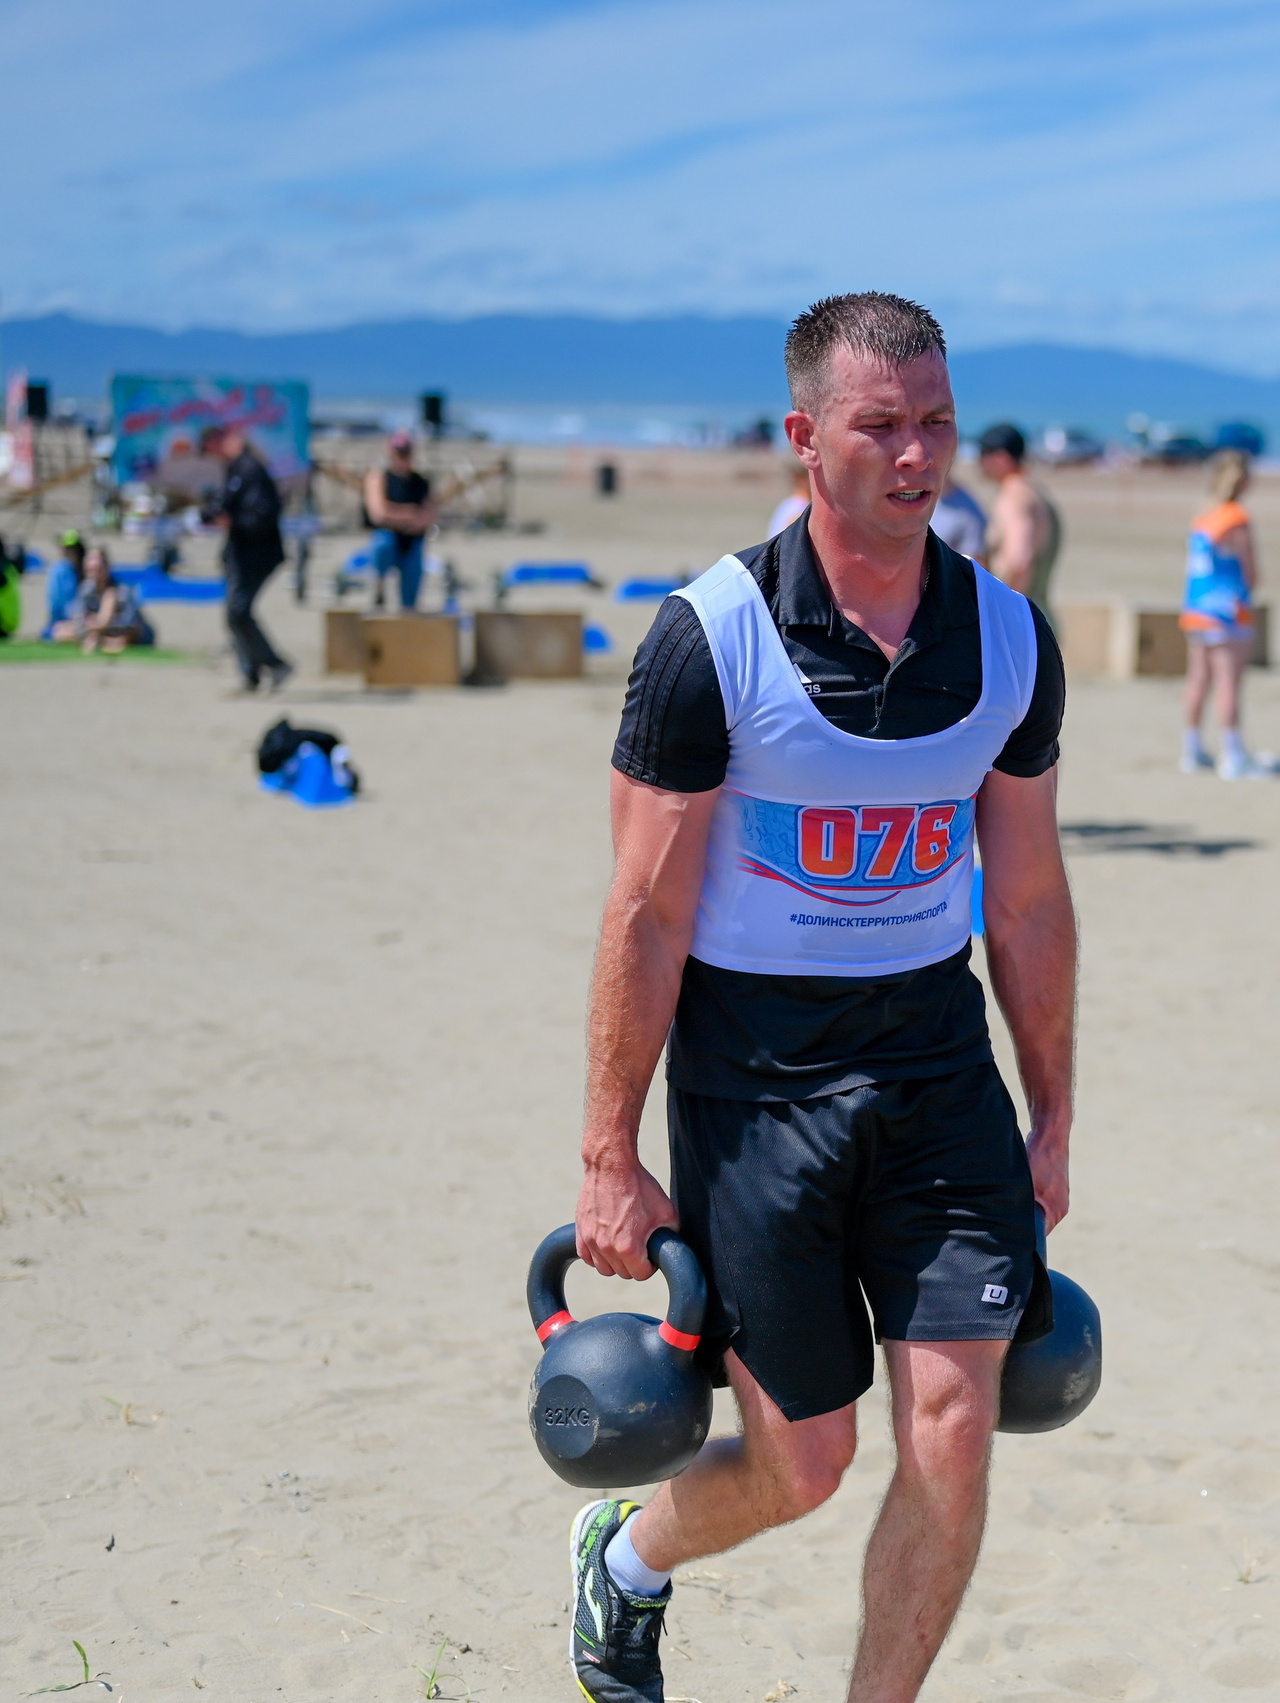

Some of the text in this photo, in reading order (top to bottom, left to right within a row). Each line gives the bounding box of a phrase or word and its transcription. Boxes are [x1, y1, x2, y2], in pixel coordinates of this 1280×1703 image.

[798, 806, 958, 880] 076
[790, 901, 947, 927] #ДОЛИНСКТЕРРИТОРИЯСПОРТА
[545, 1406, 591, 1427] 32KG
